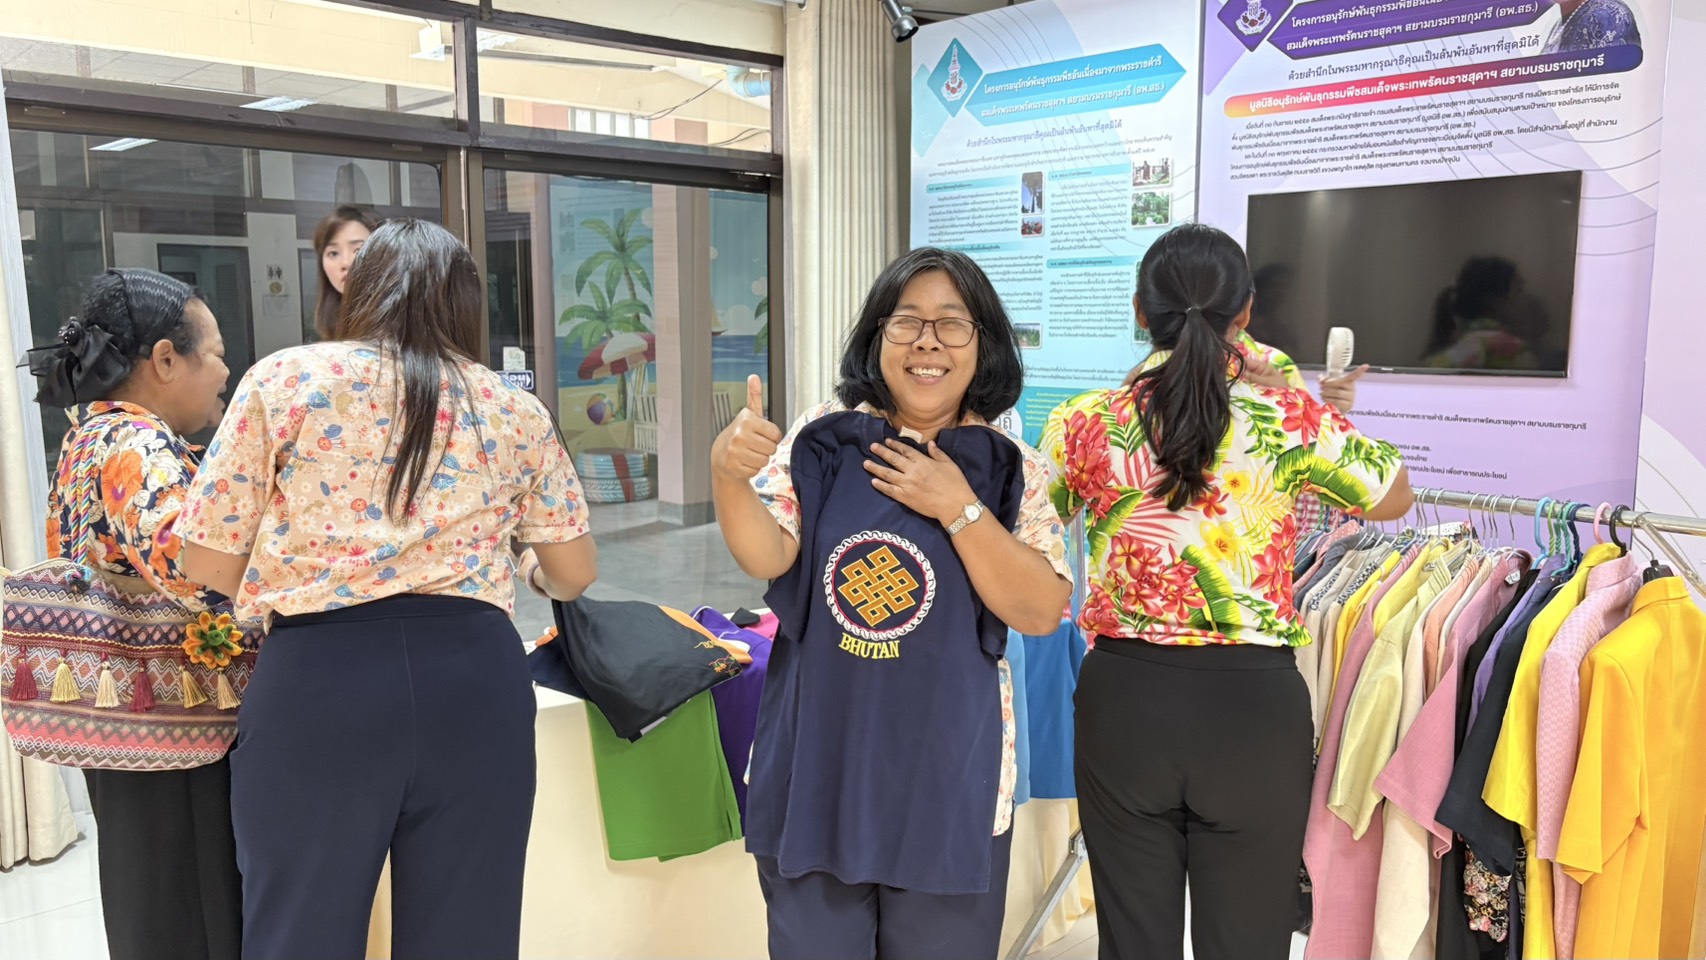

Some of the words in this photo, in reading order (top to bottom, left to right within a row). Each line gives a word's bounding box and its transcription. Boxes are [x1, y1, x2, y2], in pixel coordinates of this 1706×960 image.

[1405, 6, 1493, 32] สยามบรมราชกุมารี
[1500, 53, 1604, 78] สยามบรมราชกุมารี
[838, 632, 900, 659] BHUTAN
